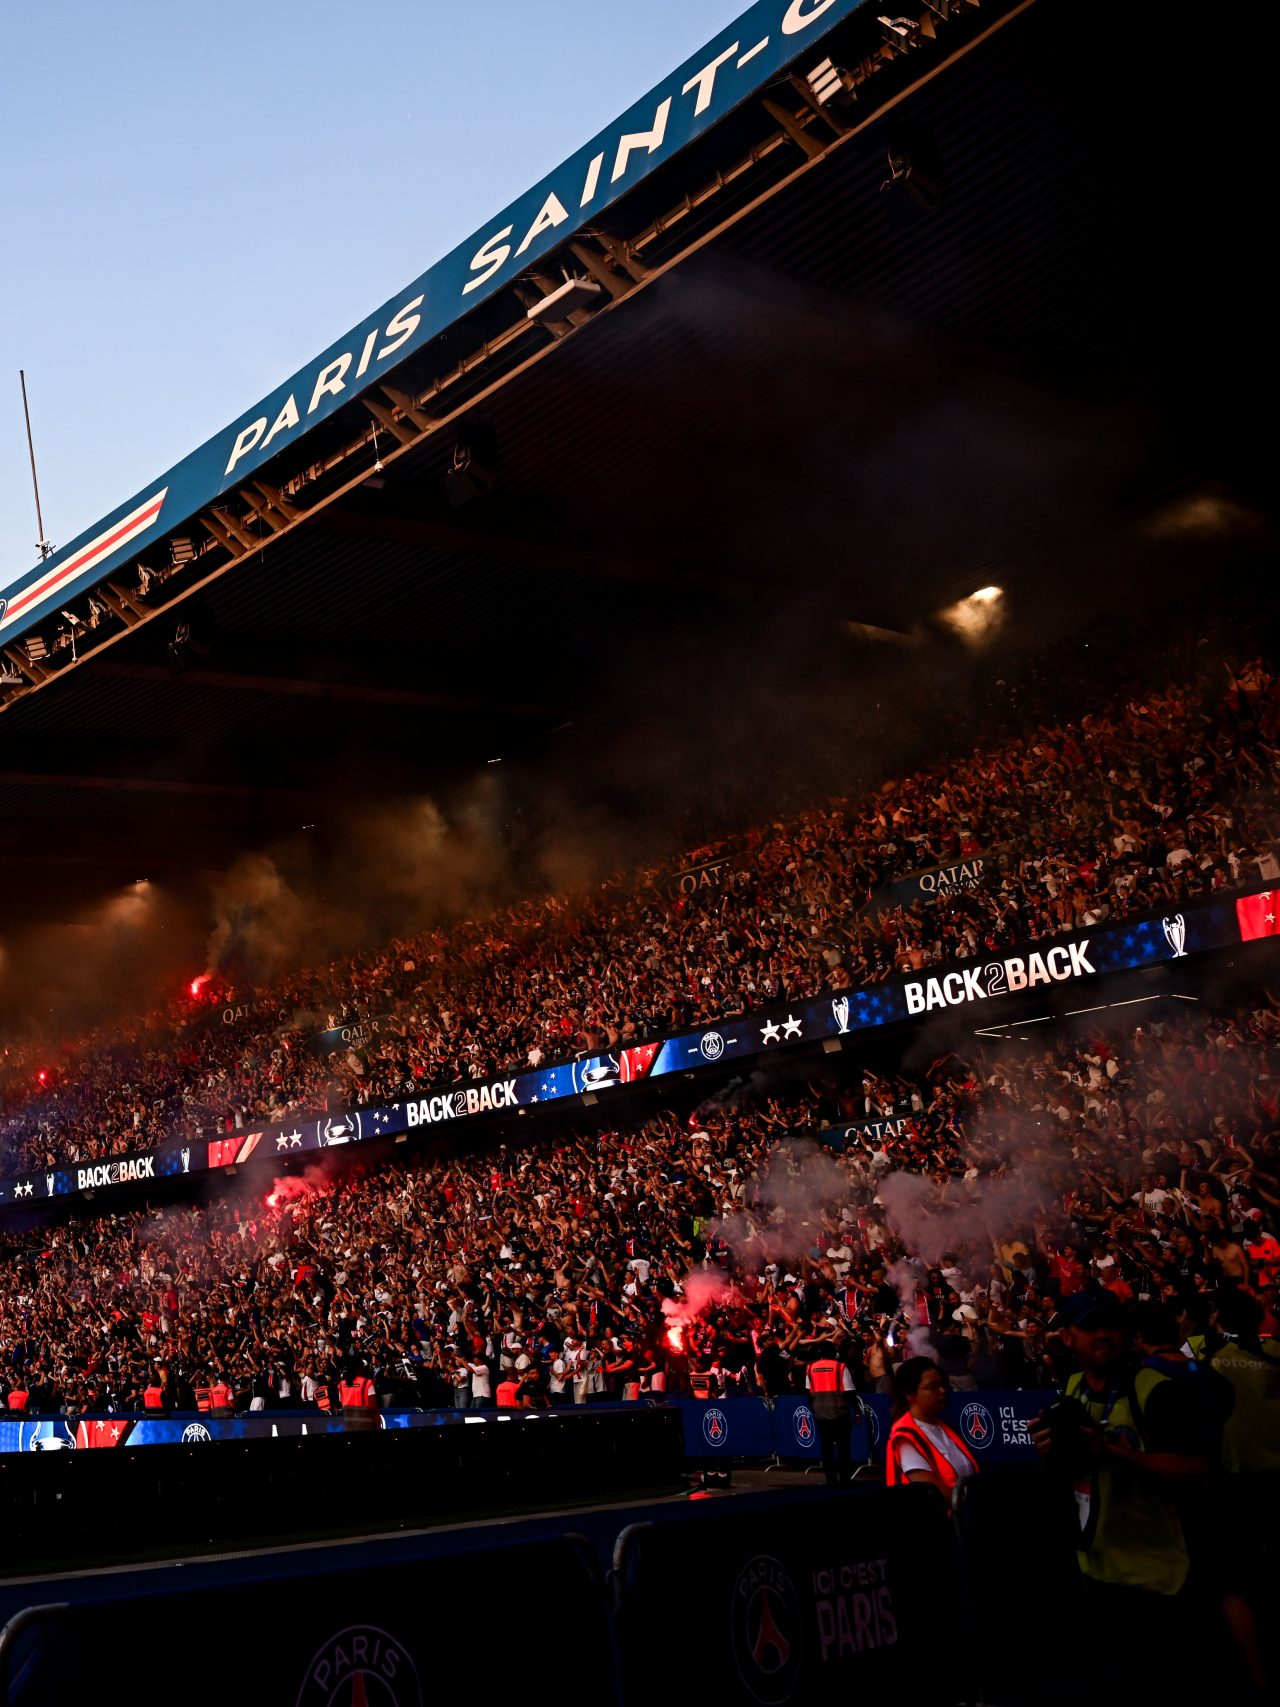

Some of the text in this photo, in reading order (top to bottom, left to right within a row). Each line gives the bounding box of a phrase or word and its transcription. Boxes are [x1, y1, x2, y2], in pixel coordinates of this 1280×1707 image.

[224, 294, 425, 477] PARIS
[679, 864, 721, 894] QAT
[919, 859, 985, 892] QATAR
[904, 939, 1095, 1015] BACK2BACK
[341, 1020, 379, 1042] QATR
[406, 1078, 519, 1127] BACK2BACK
[77, 1156, 155, 1190] BACK2BACK
[706, 1410, 723, 1420] PARIS
[964, 1405, 987, 1417] PARIS
[999, 1406, 1015, 1419] ICI
[1001, 1419, 1031, 1432] C'ES
[185, 1424, 207, 1437] PARIS
[737, 1561, 786, 1601] PARIS
[811, 1558, 888, 1596] ICI C'EST
[815, 1585, 899, 1662] PARIS
[312, 1635, 400, 1693] PARIS
